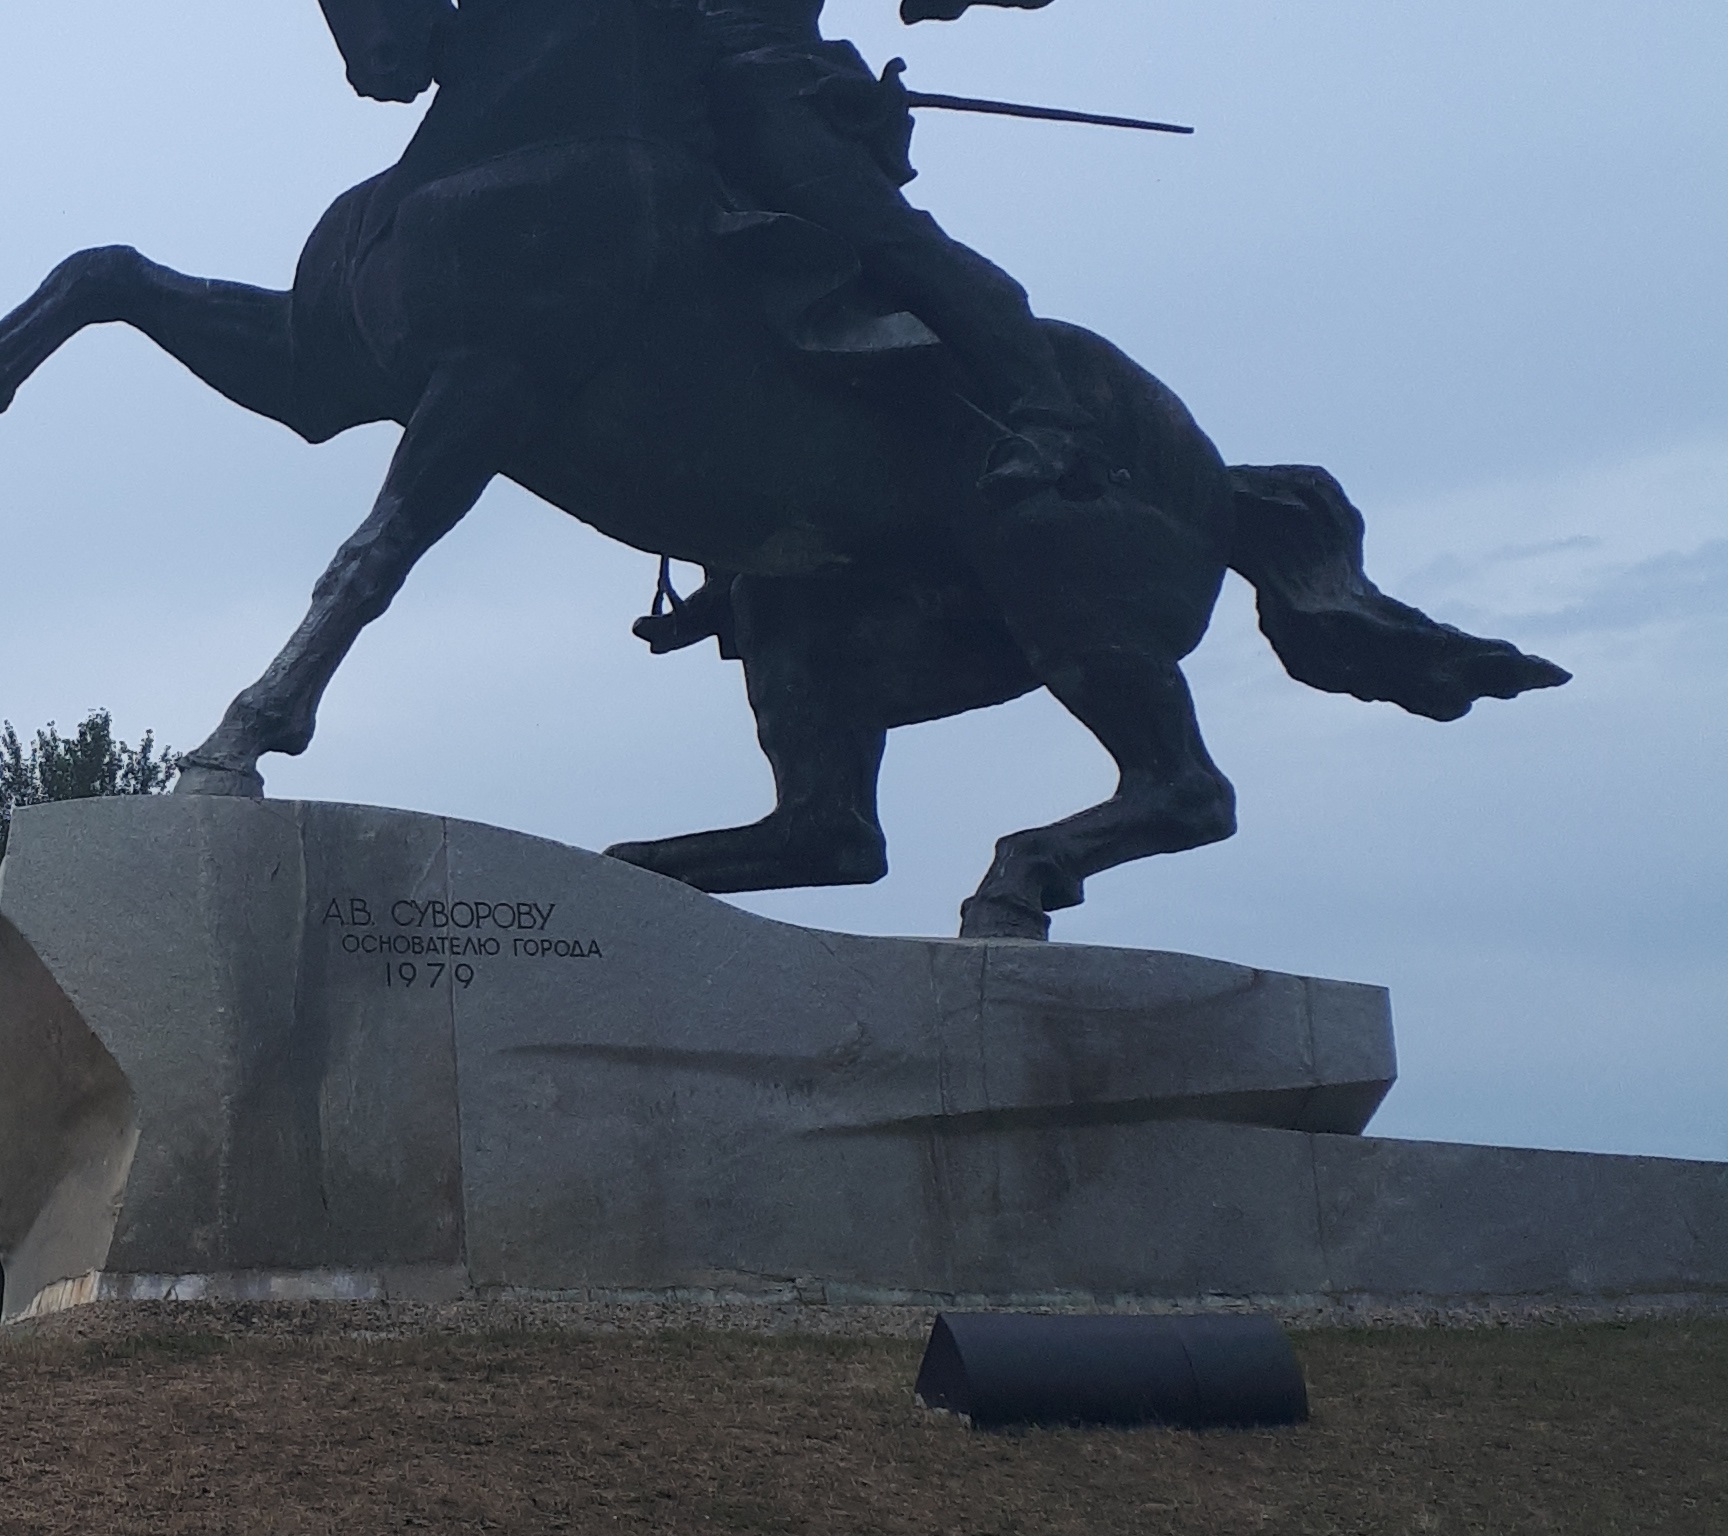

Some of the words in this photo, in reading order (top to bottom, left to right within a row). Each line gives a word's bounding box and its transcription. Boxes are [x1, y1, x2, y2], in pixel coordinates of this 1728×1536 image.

[391, 899, 556, 931] СУВОРОВУ
[341, 934, 501, 957] ОСНОВАТЕЛЮ
[513, 938, 603, 959] ГОРОДА
[384, 961, 475, 989] 1979
